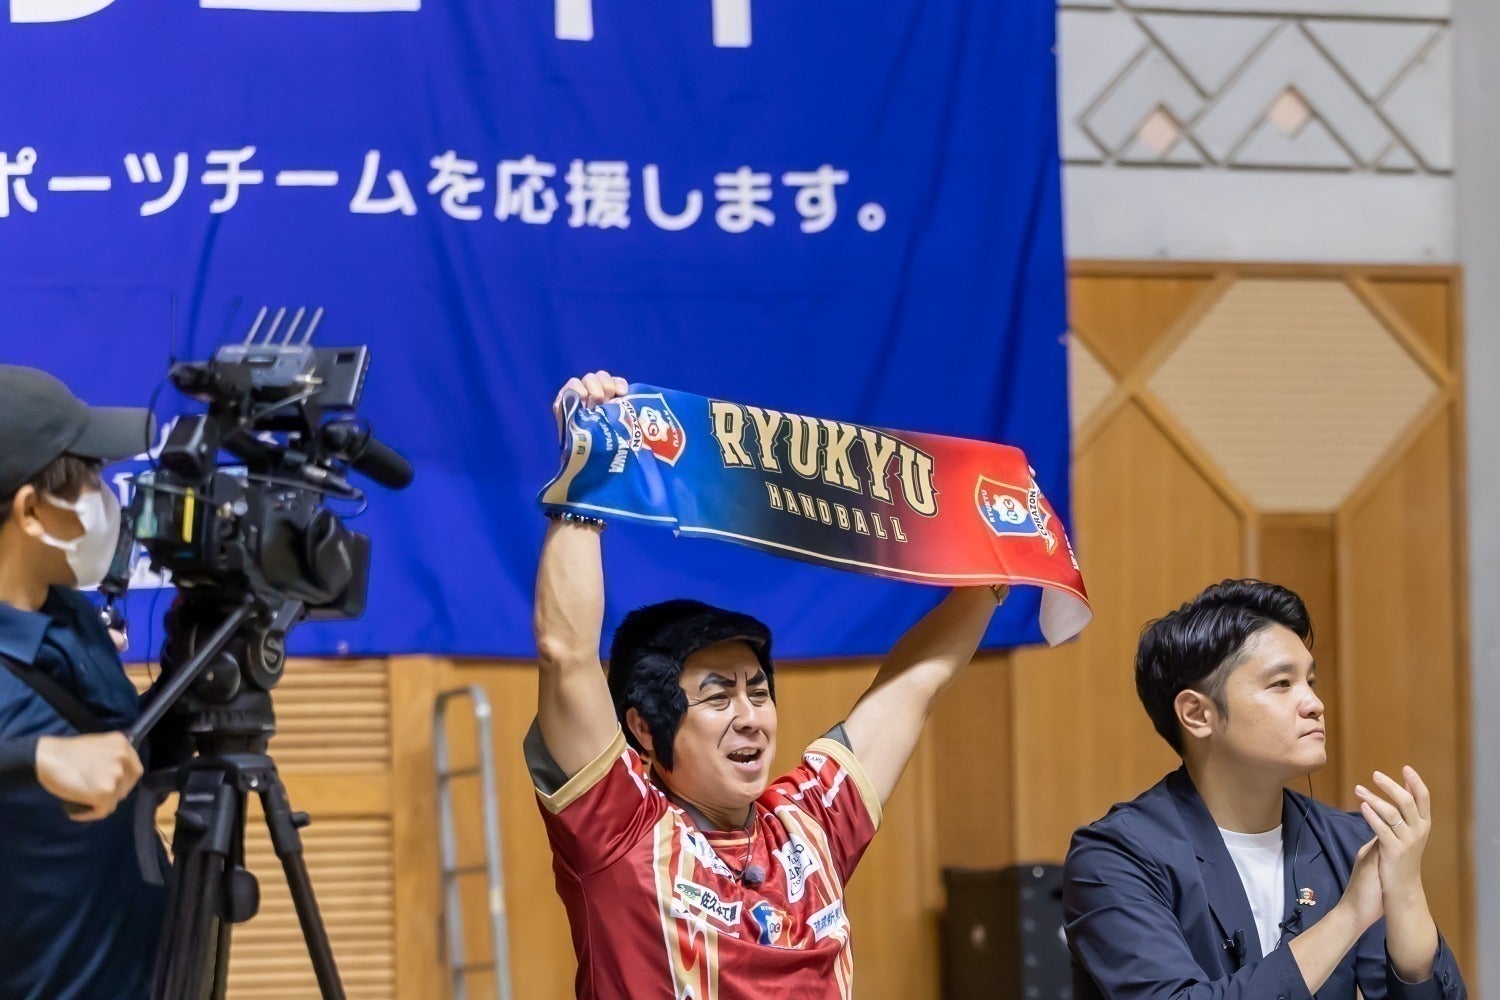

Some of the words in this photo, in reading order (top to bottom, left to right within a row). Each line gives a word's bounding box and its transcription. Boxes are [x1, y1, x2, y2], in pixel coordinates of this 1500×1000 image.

[600, 422, 614, 451] JAPAN
[708, 399, 939, 517] RYUKYU
[765, 482, 907, 542] HANDBALL
[981, 489, 996, 523] RYUKYU
[1029, 490, 1048, 536] CORAZON
